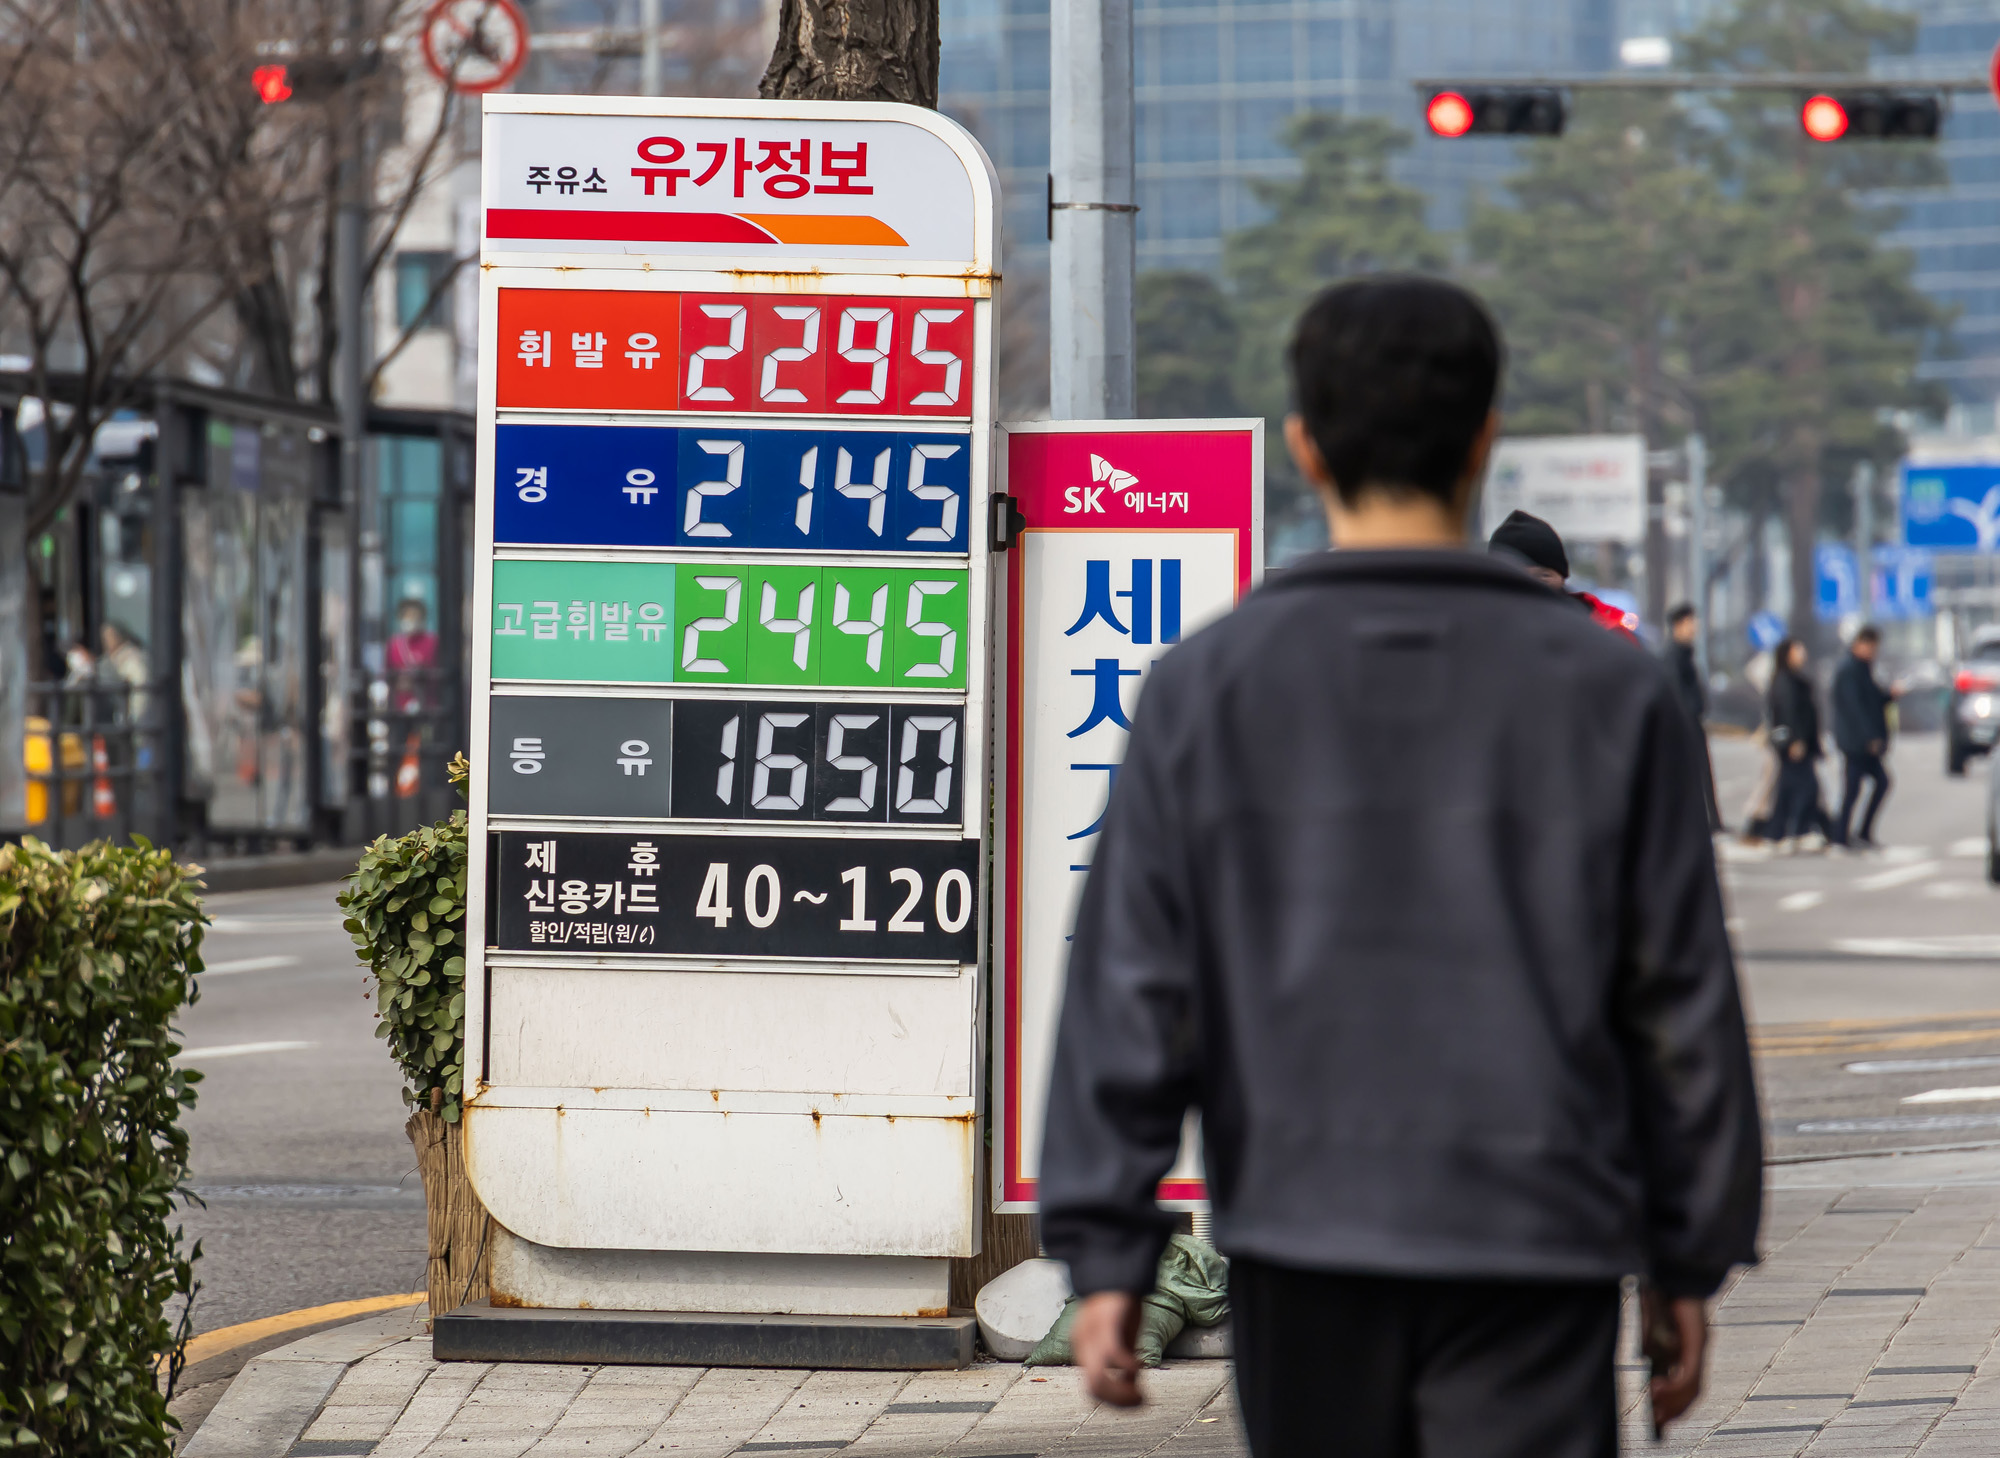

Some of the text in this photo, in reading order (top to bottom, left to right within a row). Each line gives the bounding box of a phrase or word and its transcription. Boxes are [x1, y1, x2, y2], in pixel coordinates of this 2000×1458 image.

[526, 136, 875, 200] 주유소 유가정보
[517, 304, 966, 406] 휘발유 2295
[683, 440, 961, 543] 2145
[1063, 486, 1190, 515] SK 에너지
[494, 575, 959, 679] 고급휘발유 2445
[715, 712, 958, 815] 1650
[524, 879, 660, 915] 신용카드
